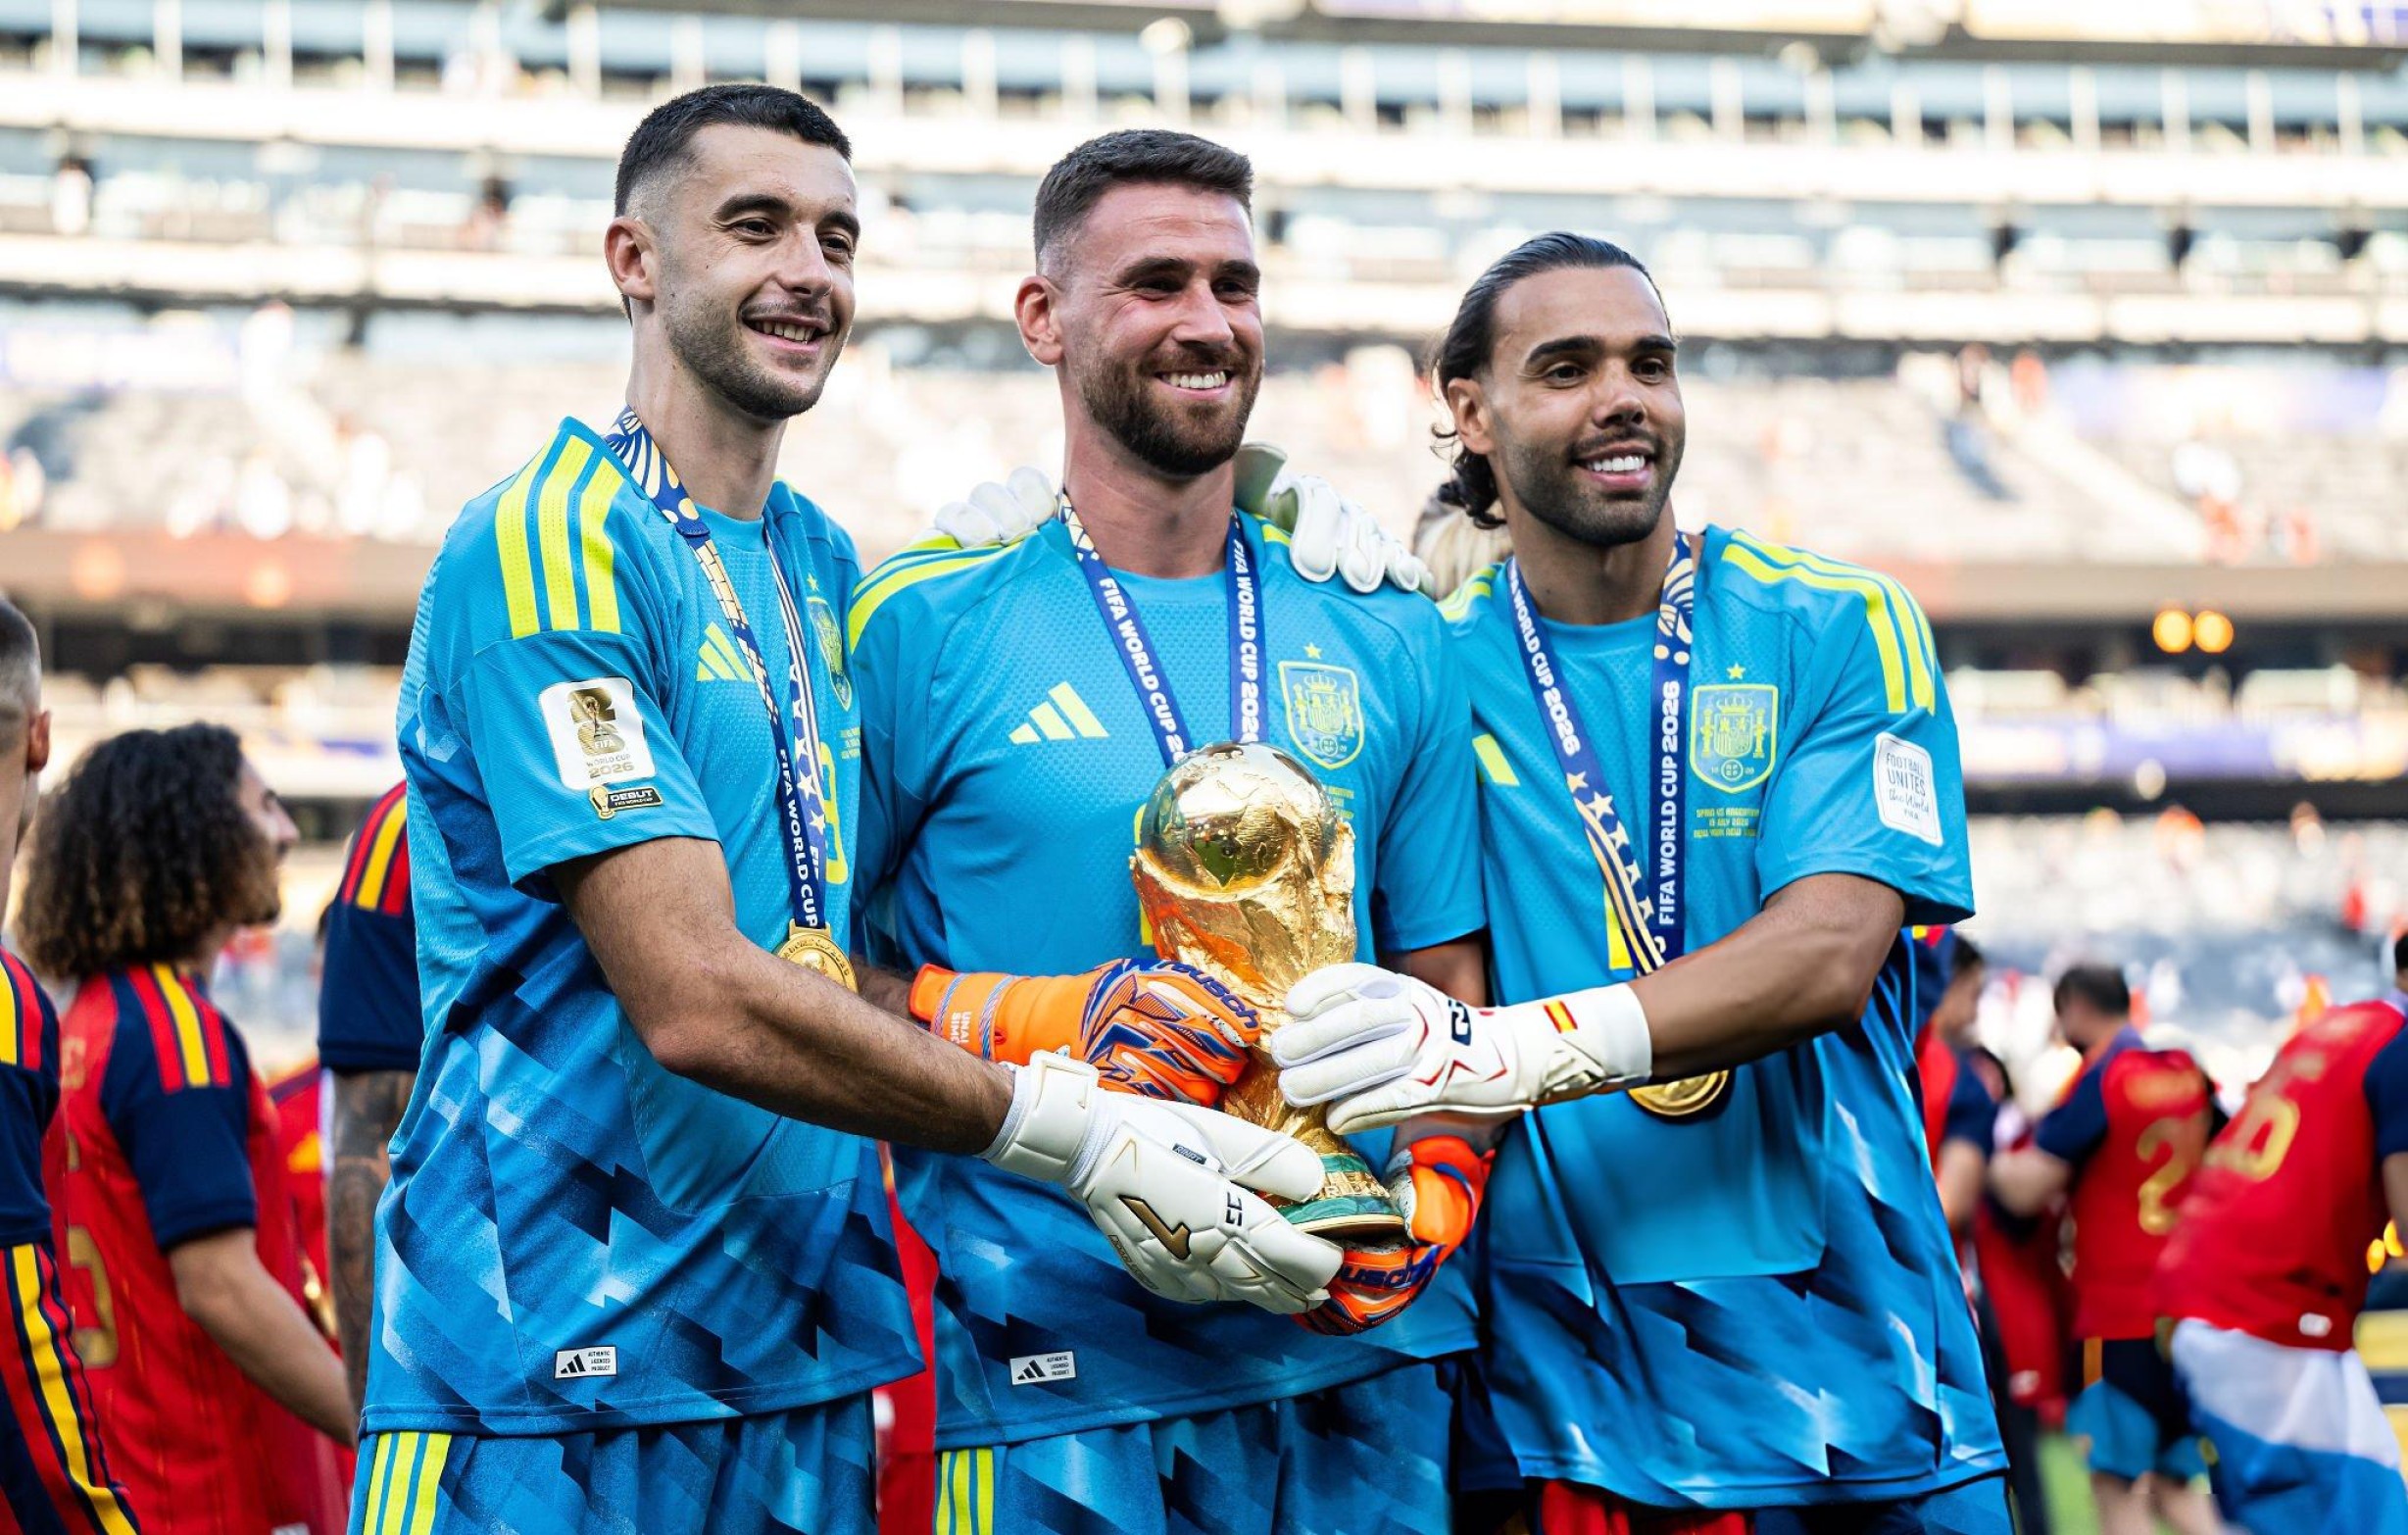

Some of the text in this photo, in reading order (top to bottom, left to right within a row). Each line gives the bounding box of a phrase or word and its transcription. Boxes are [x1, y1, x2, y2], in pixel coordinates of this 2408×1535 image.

[1234, 538, 1249, 573] FIFA
[1237, 576, 1256, 641] WORLD
[1099, 577, 1128, 620] FIFA
[1117, 619, 1159, 691] WORLD
[1150, 692, 1177, 732] CUP
[1240, 641, 1258, 681] CUP
[1513, 588, 1581, 756] WORLD CUP 2026
[1661, 680, 1681, 753] 2026
[594, 738, 616, 750] FIFA
[615, 753, 632, 763] CUP
[588, 761, 635, 779] 2026
[1661, 755, 1678, 798] CUP
[1887, 752, 1924, 777] FOOTBALL
[1888, 767, 1926, 797] UNITES
[610, 788, 654, 802] DEBUT
[780, 749, 818, 927] FIFA WORLD CUP
[1659, 800, 1677, 877] WORLD
[1659, 880, 1676, 925] FIFA
[959, 1011, 972, 1044] UNAI
